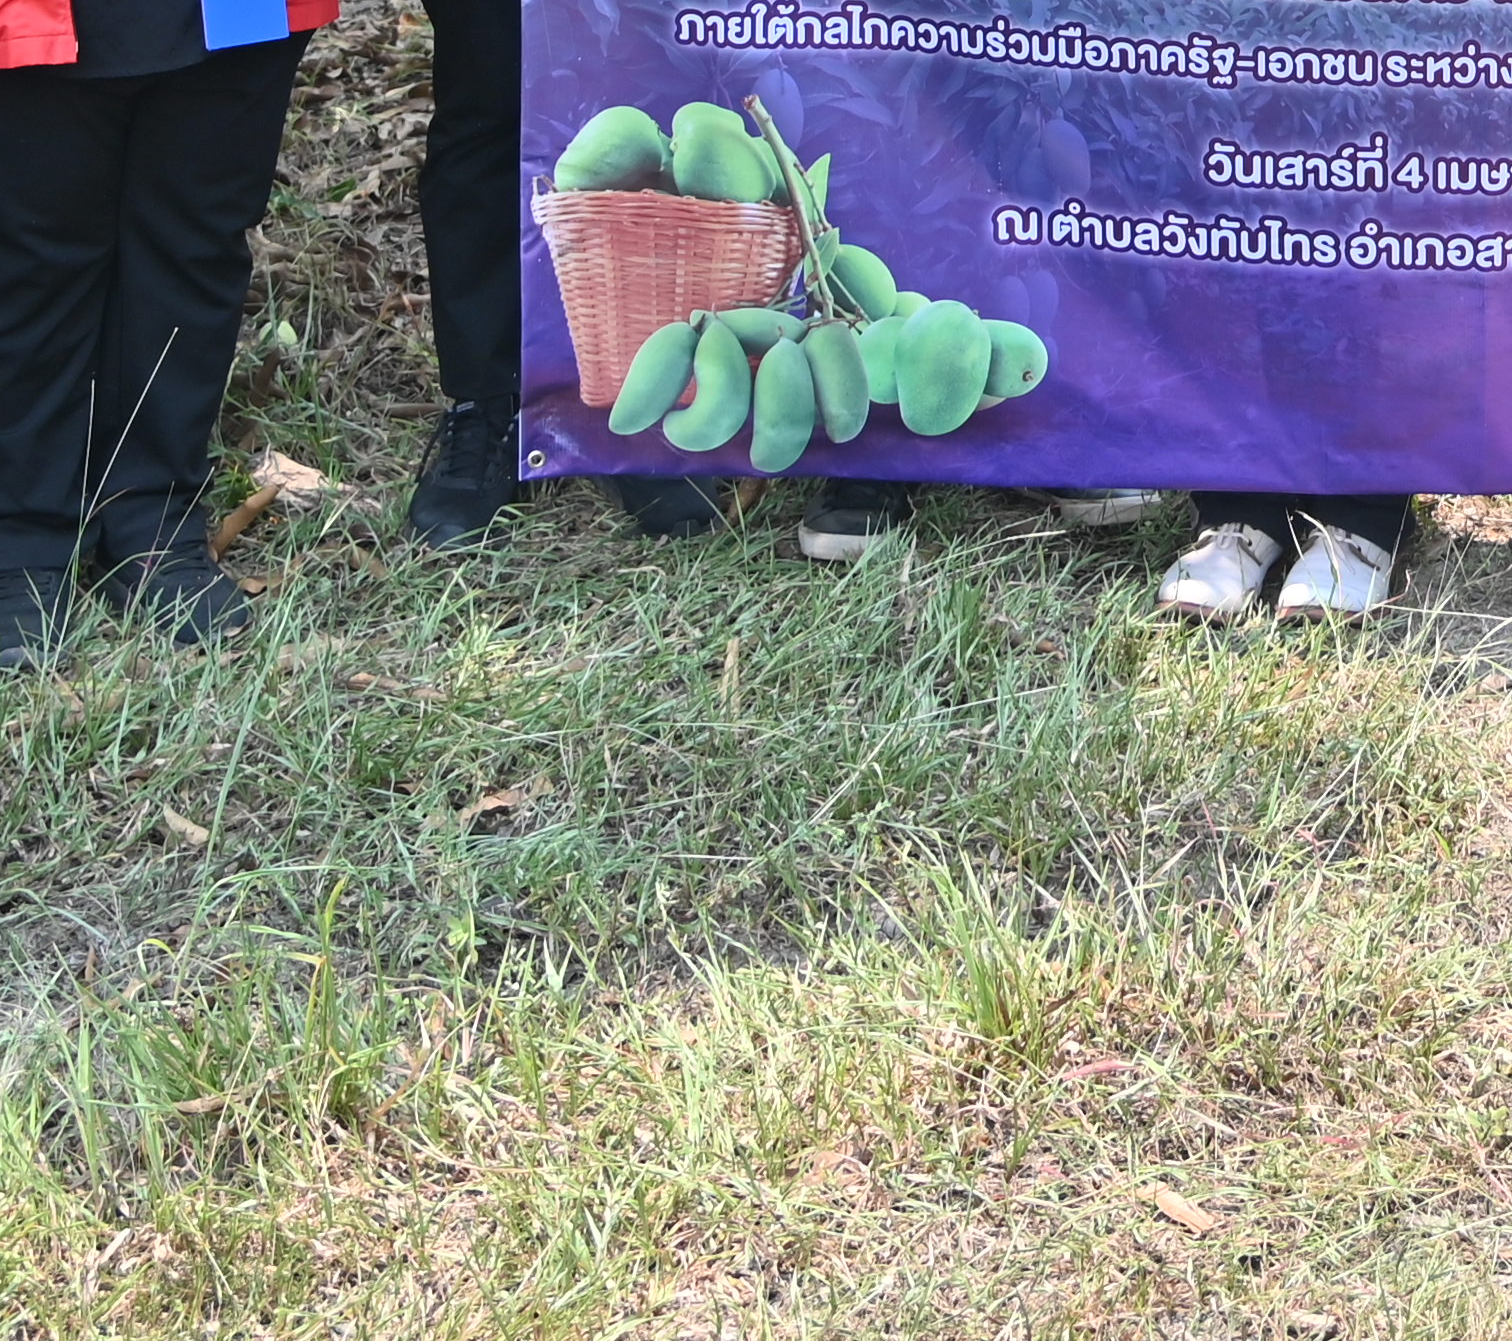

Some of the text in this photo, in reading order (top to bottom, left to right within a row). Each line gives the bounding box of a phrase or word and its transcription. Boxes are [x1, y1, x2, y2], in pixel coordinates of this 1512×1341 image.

[678, 5, 1373, 86] ภายใต้กลไกความร่วมมือภาครัฐ-เอกชน
[1207, 136, 1384, 188] วันเสาร์ที่
[1396, 156, 1424, 189] 4
[996, 208, 1038, 241] ณ
[1053, 202, 1336, 263] ตำบลวังทับไทร
